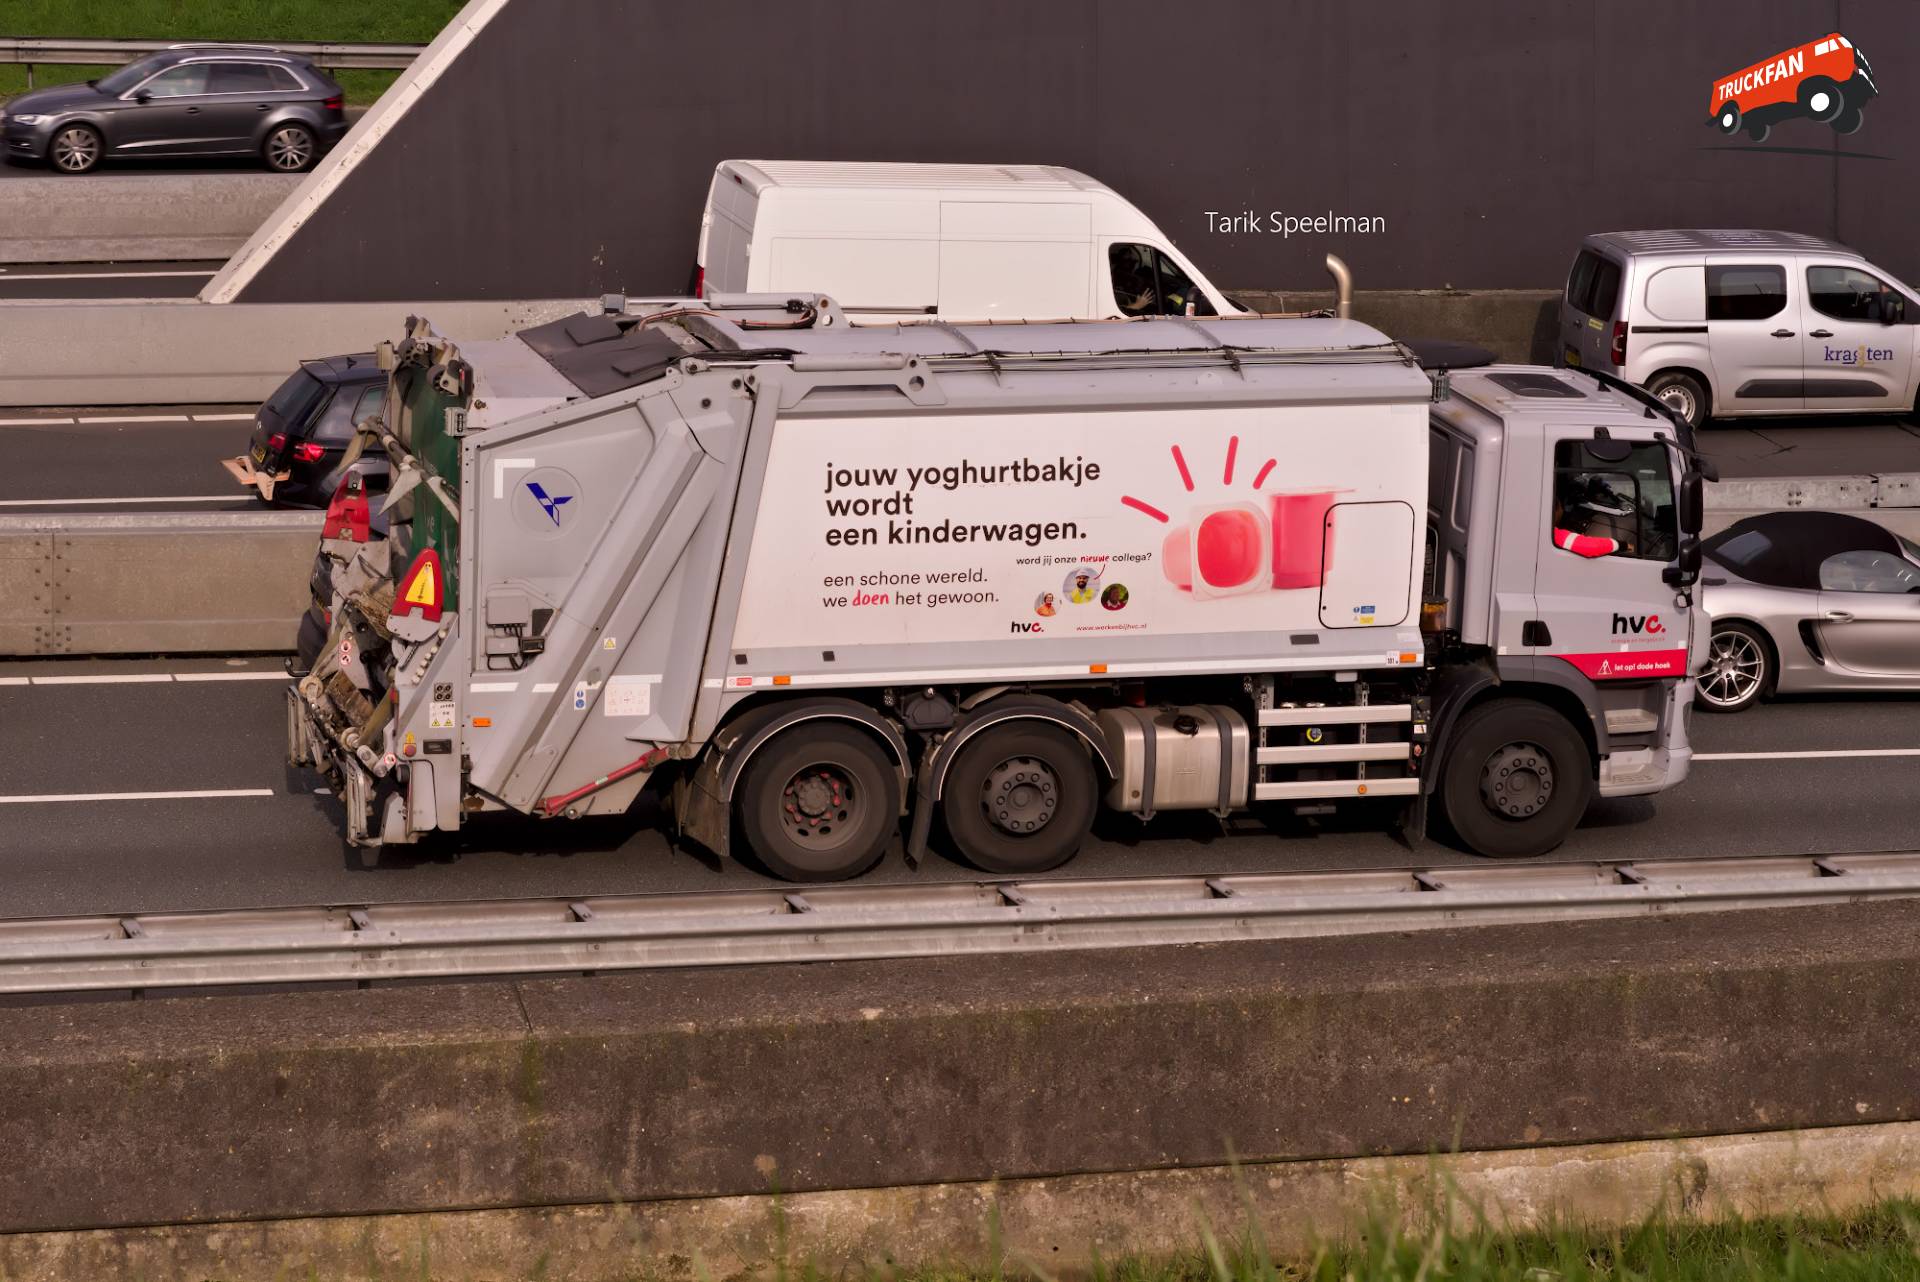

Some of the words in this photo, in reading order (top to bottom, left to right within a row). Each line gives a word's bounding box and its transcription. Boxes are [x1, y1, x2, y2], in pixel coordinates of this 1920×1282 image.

[824, 462, 897, 494] jouw
[906, 455, 1101, 492] yoghurtbakje
[825, 490, 914, 517] wordt
[825, 527, 878, 547] een
[888, 518, 1087, 547] kinderwagen.
[1016, 555, 1041, 566] word
[1043, 555, 1052, 566] jij
[1080, 554, 1110, 563] nieuwe
[1112, 552, 1152, 565] collega?
[823, 576, 855, 588] een
[859, 570, 921, 587] schone
[925, 567, 988, 585] wereld.
[822, 596, 848, 608] we
[852, 589, 890, 607] doen
[895, 591, 922, 606] het
[927, 592, 999, 609] gewoon.
[1010, 620, 1045, 634] hvc.
[1611, 612, 1666, 635] hvc.
[1636, 662, 1654, 670] dode
